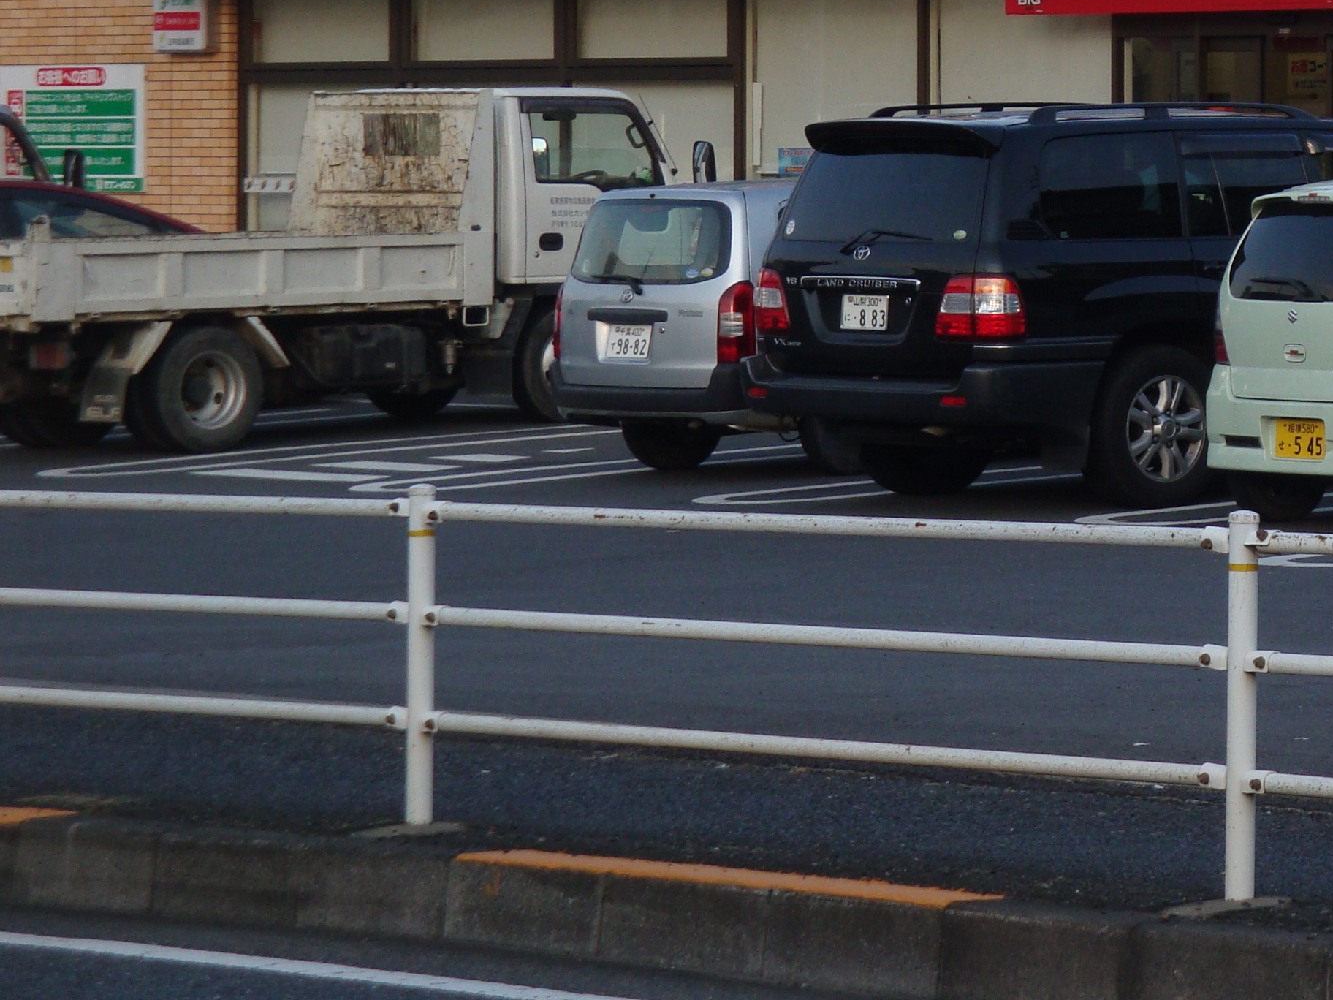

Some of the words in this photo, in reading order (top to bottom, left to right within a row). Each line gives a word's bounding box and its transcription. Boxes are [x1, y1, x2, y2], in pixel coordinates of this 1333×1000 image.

[817, 279, 844, 287] LAND
[848, 280, 898, 288] CRUISER
[616, 338, 647, 356] 98-82
